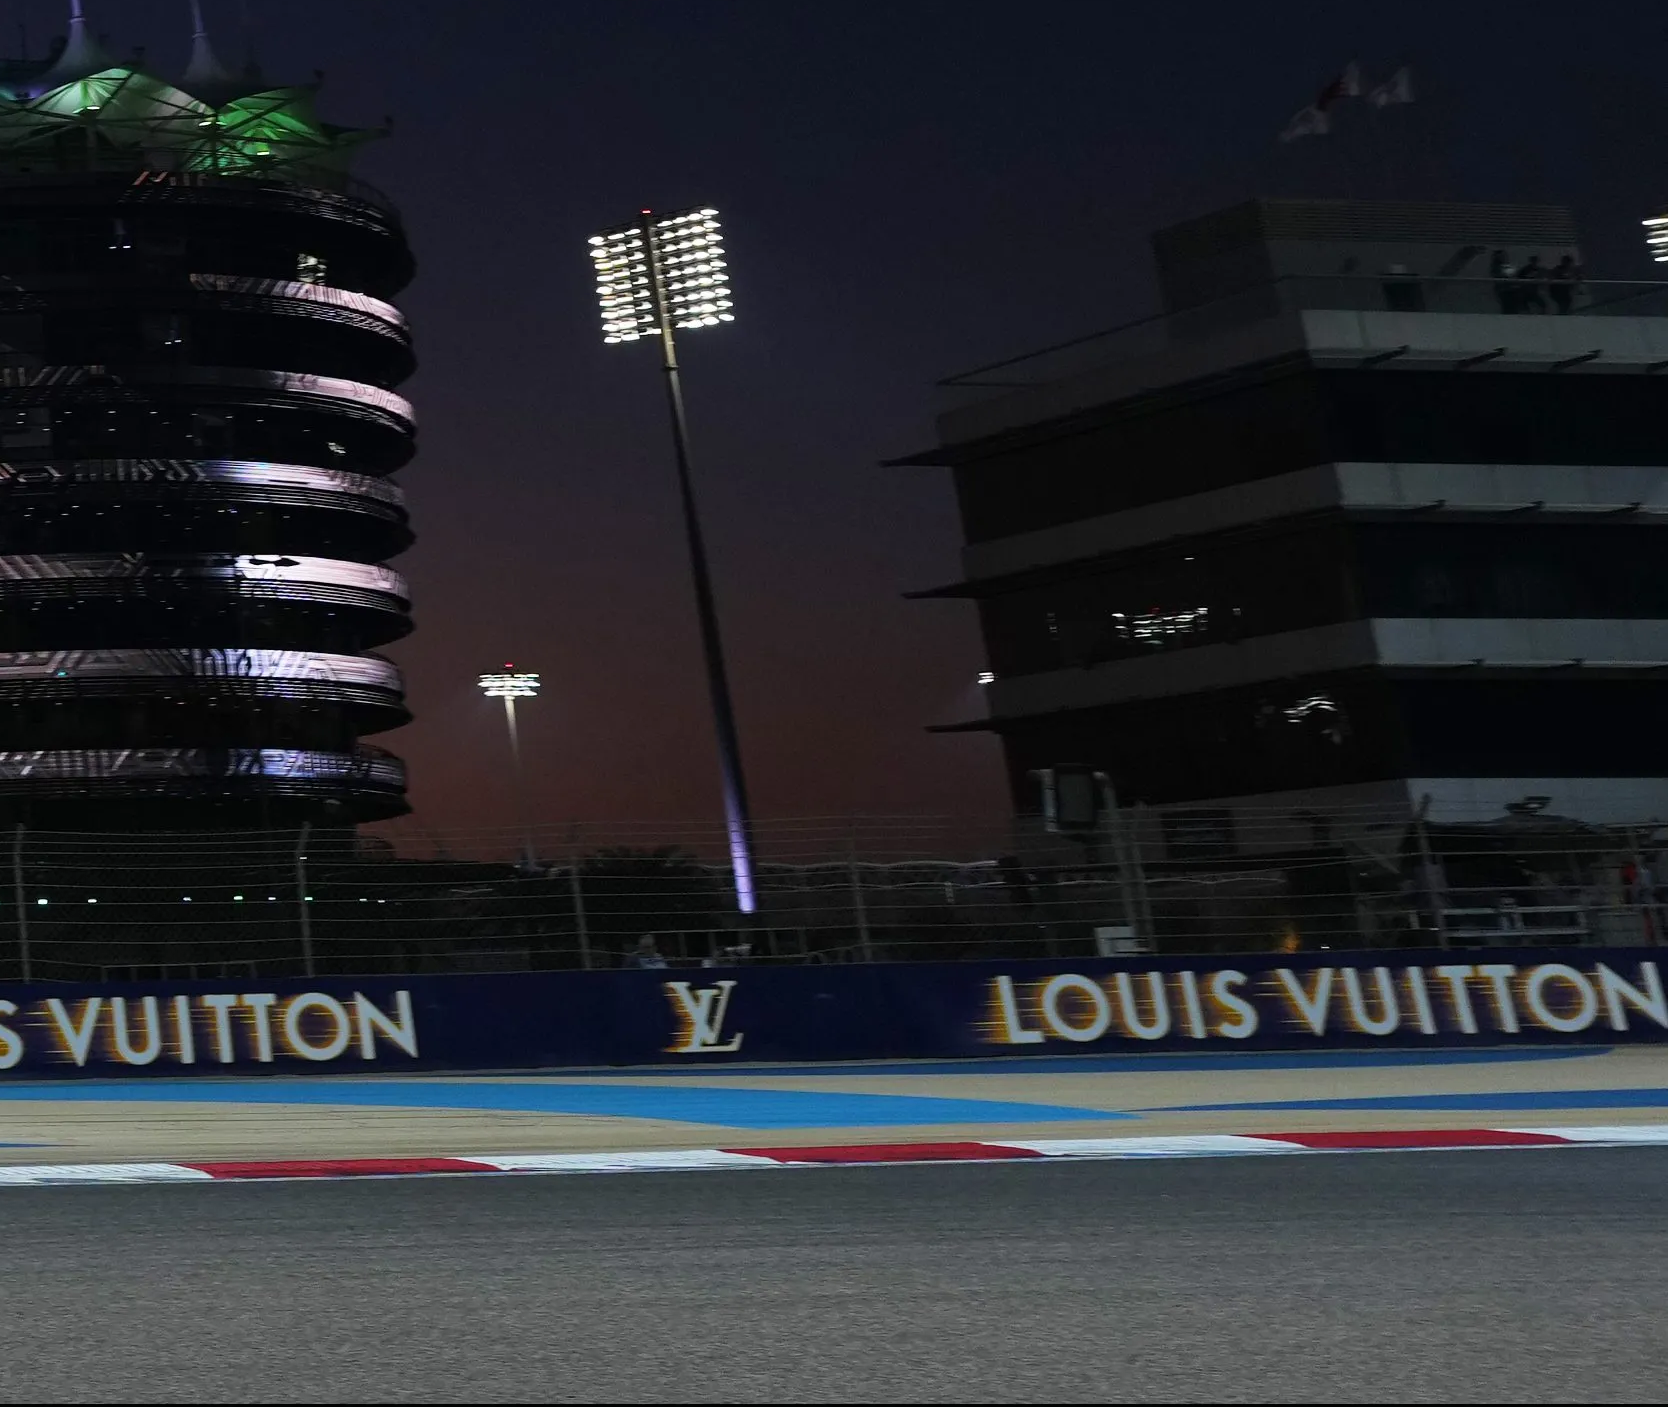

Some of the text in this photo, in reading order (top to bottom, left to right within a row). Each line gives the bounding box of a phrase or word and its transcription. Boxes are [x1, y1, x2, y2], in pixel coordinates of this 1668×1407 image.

[47, 990, 418, 1067] VUITTON
[994, 961, 1668, 1044] LOUIS VUITTON
